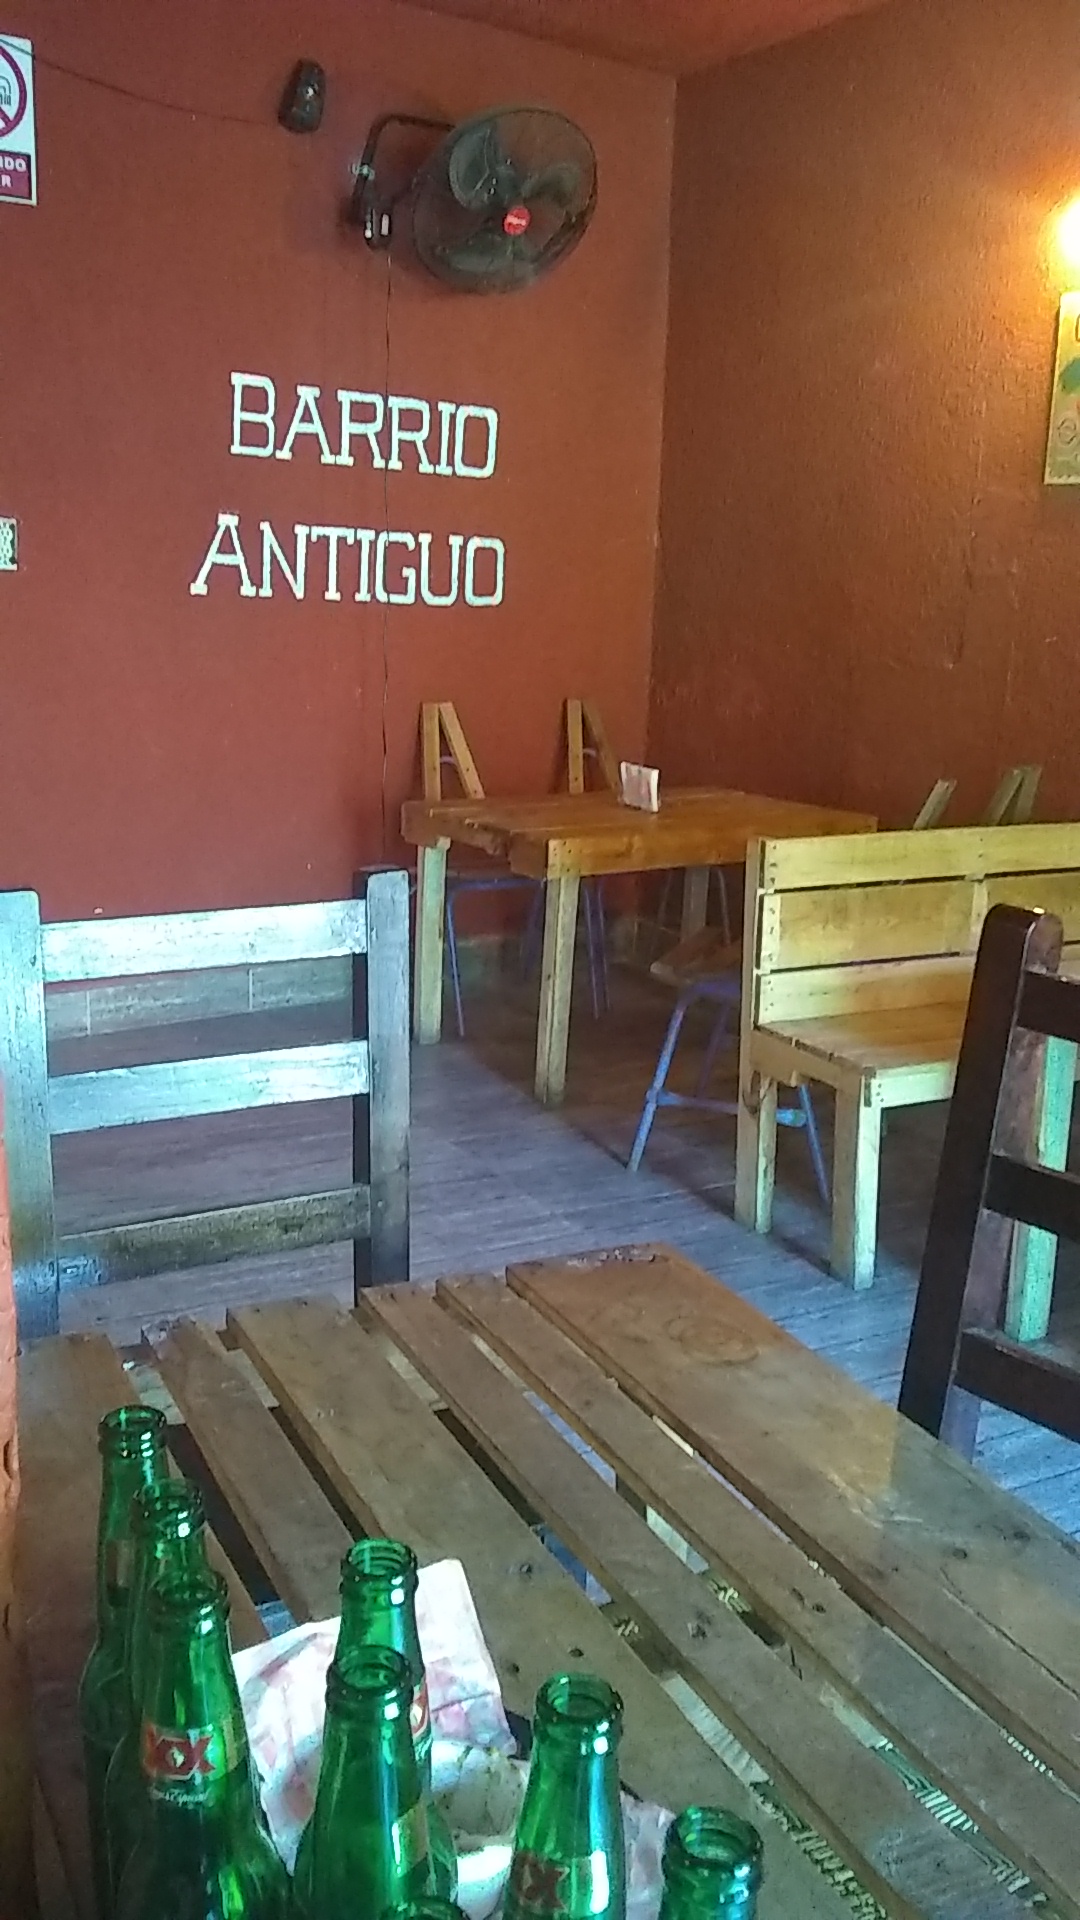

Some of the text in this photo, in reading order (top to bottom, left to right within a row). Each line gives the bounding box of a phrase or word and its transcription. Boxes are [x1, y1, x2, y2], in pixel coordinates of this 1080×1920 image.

[0, 174, 12, 188] R
[230, 371, 499, 479] BARRIO
[190, 513, 505, 607] ANTIGUO
